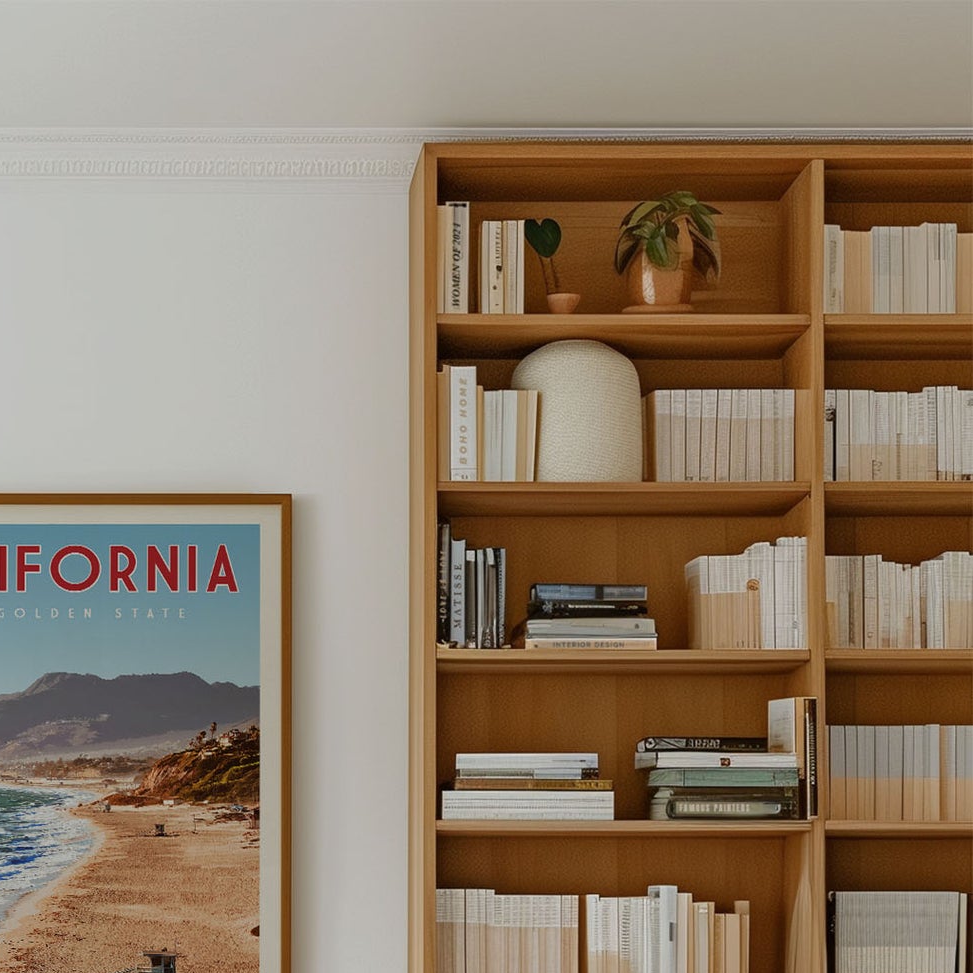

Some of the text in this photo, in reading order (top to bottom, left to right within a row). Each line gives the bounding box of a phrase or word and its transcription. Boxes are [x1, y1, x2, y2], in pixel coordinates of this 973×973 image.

[452, 222, 461, 307] WOMEN OF 2024
[459, 377, 467, 465] BOHO HOME
[115, 607, 187, 619] STATE
[453, 563, 462, 629] MATISSE
[678, 803, 750, 813] FAMOUS PAINTERS
